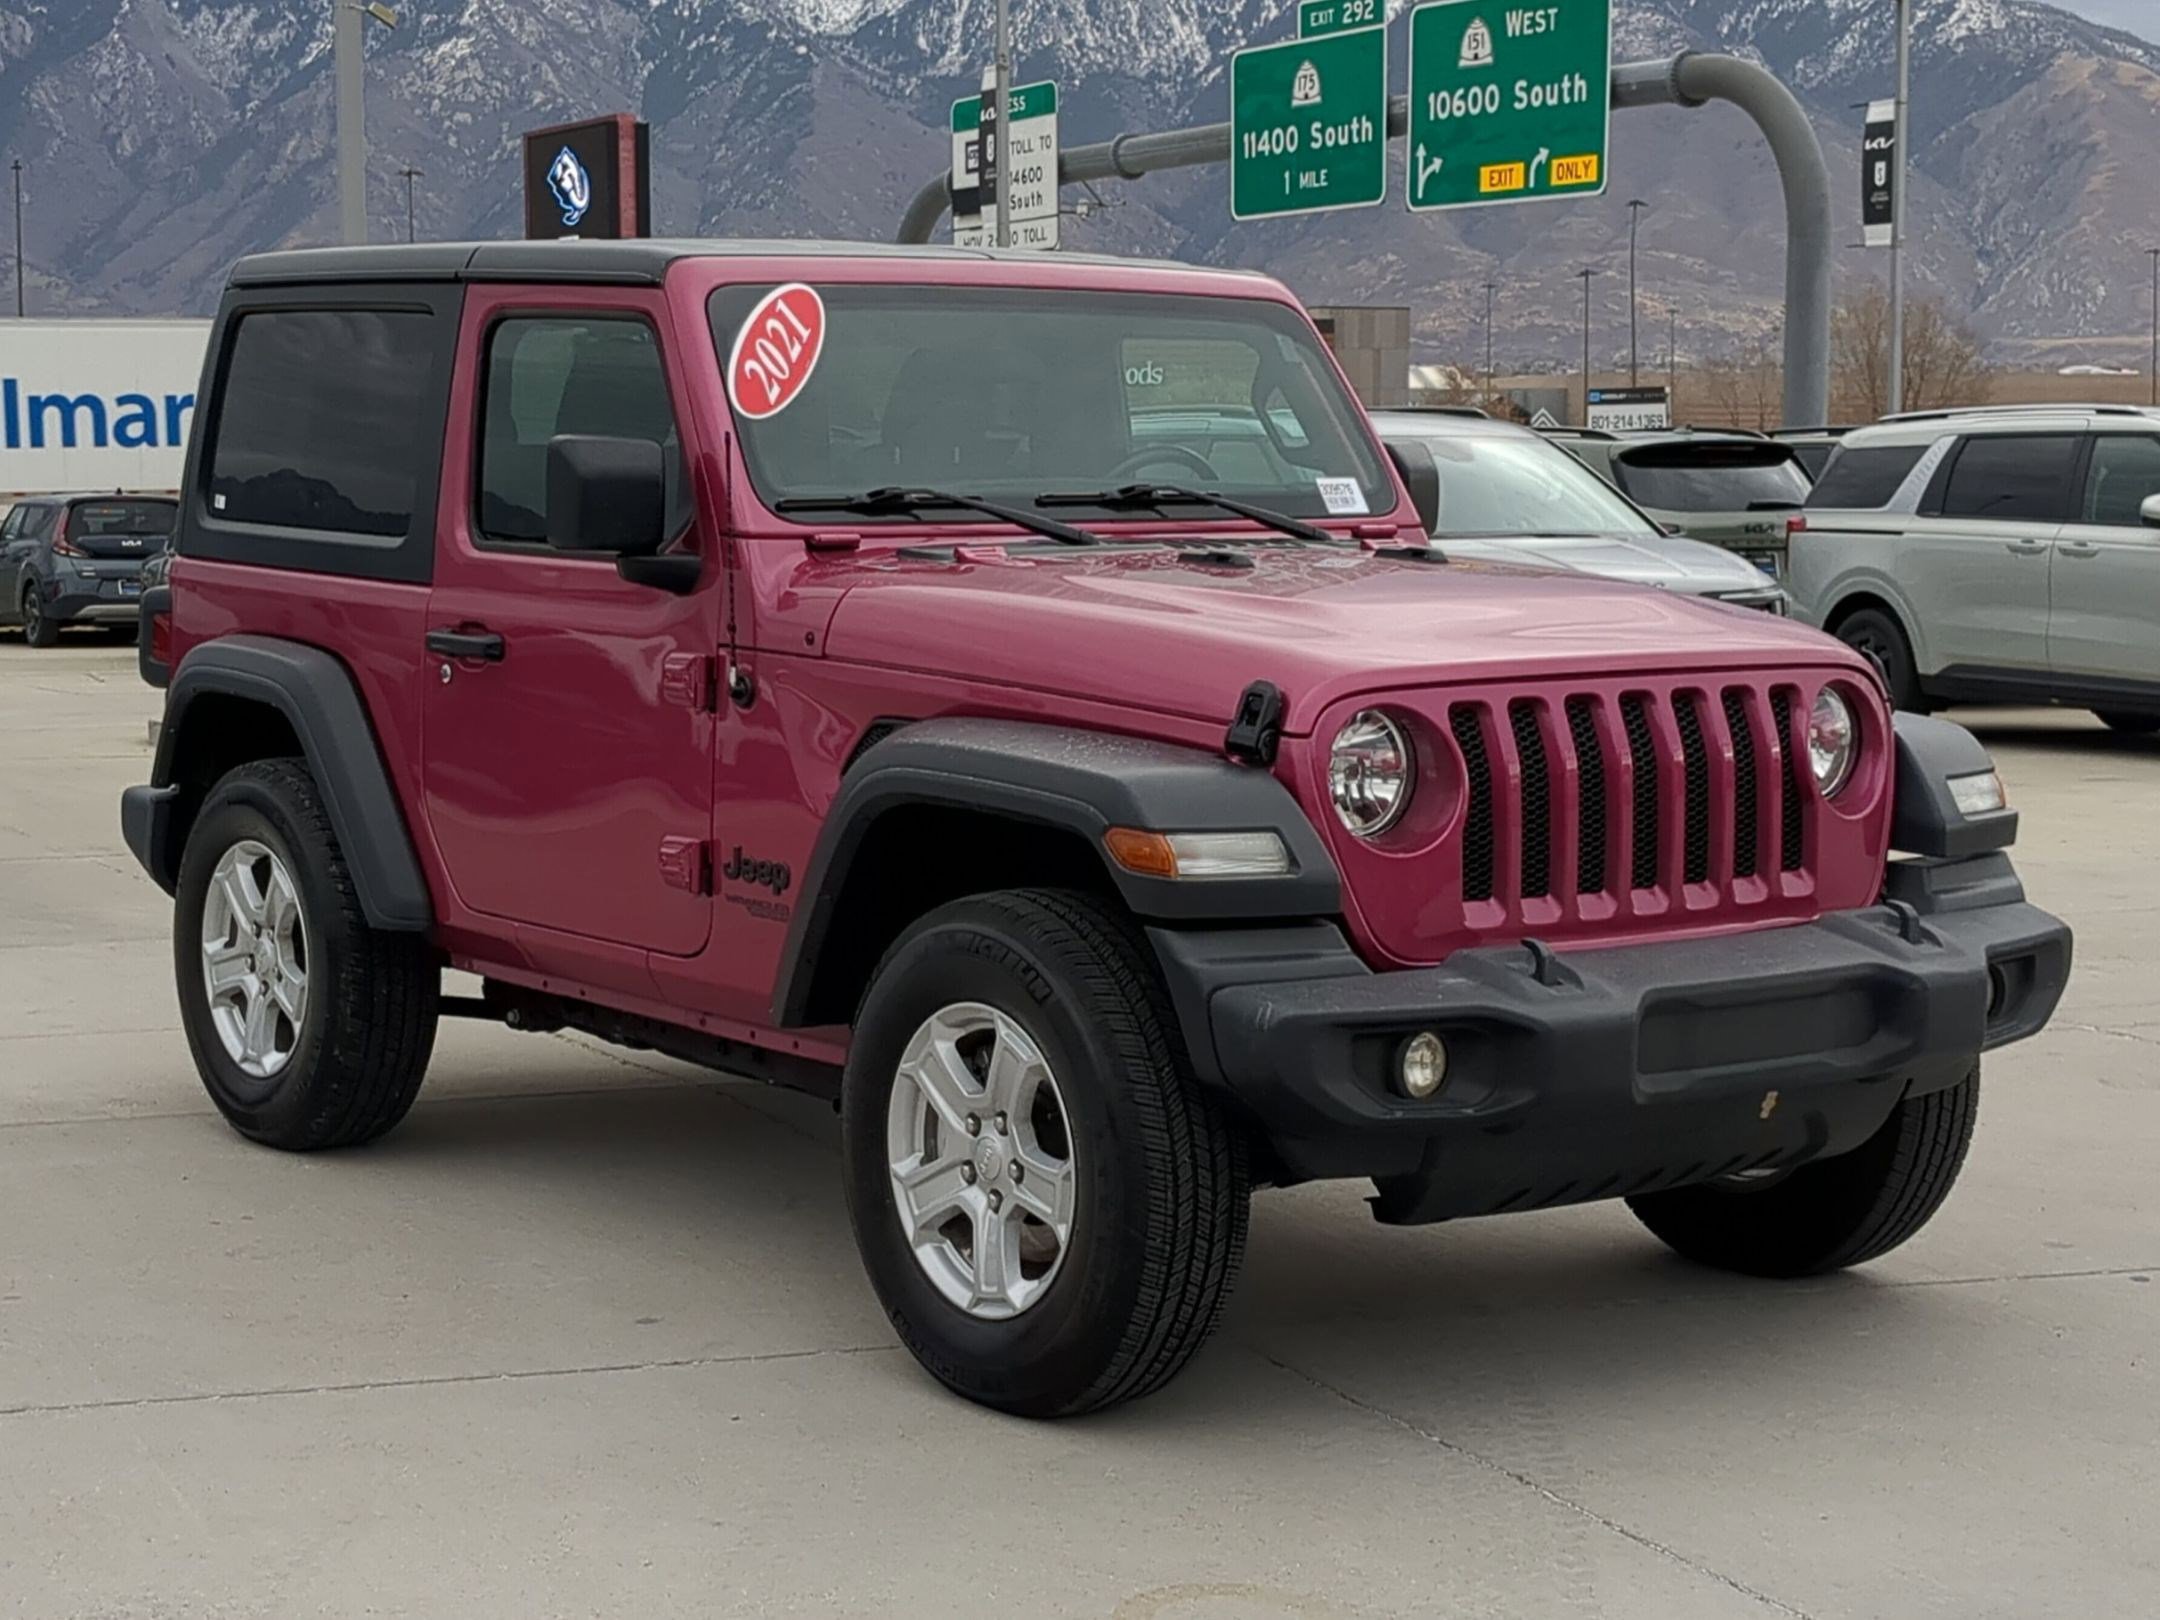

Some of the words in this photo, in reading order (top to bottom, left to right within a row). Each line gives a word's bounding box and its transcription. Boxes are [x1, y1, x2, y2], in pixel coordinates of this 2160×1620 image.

[1310, 9, 1335, 27] EXIT
[1342, 1, 1374, 24] 292
[1506, 8, 1558, 38] WEST
[1467, 32, 1485, 51] 151
[1298, 74, 1316, 92] 175
[1428, 84, 1500, 121] 10600
[1513, 73, 1587, 110] South
[1010, 139, 1034, 156] TOLL
[1039, 135, 1052, 151] TO
[1243, 125, 1298, 159] 11400
[1310, 115, 1373, 149] South
[1284, 170, 1290, 195] 1
[1299, 169, 1328, 189] MILE
[1489, 168, 1514, 187] EXIT
[1556, 160, 1592, 181] ONLY
[1010, 191, 1043, 211] South
[1024, 227, 1048, 243] TOLL
[744, 298, 811, 406] 2021
[723, 845, 791, 897] Jeep
